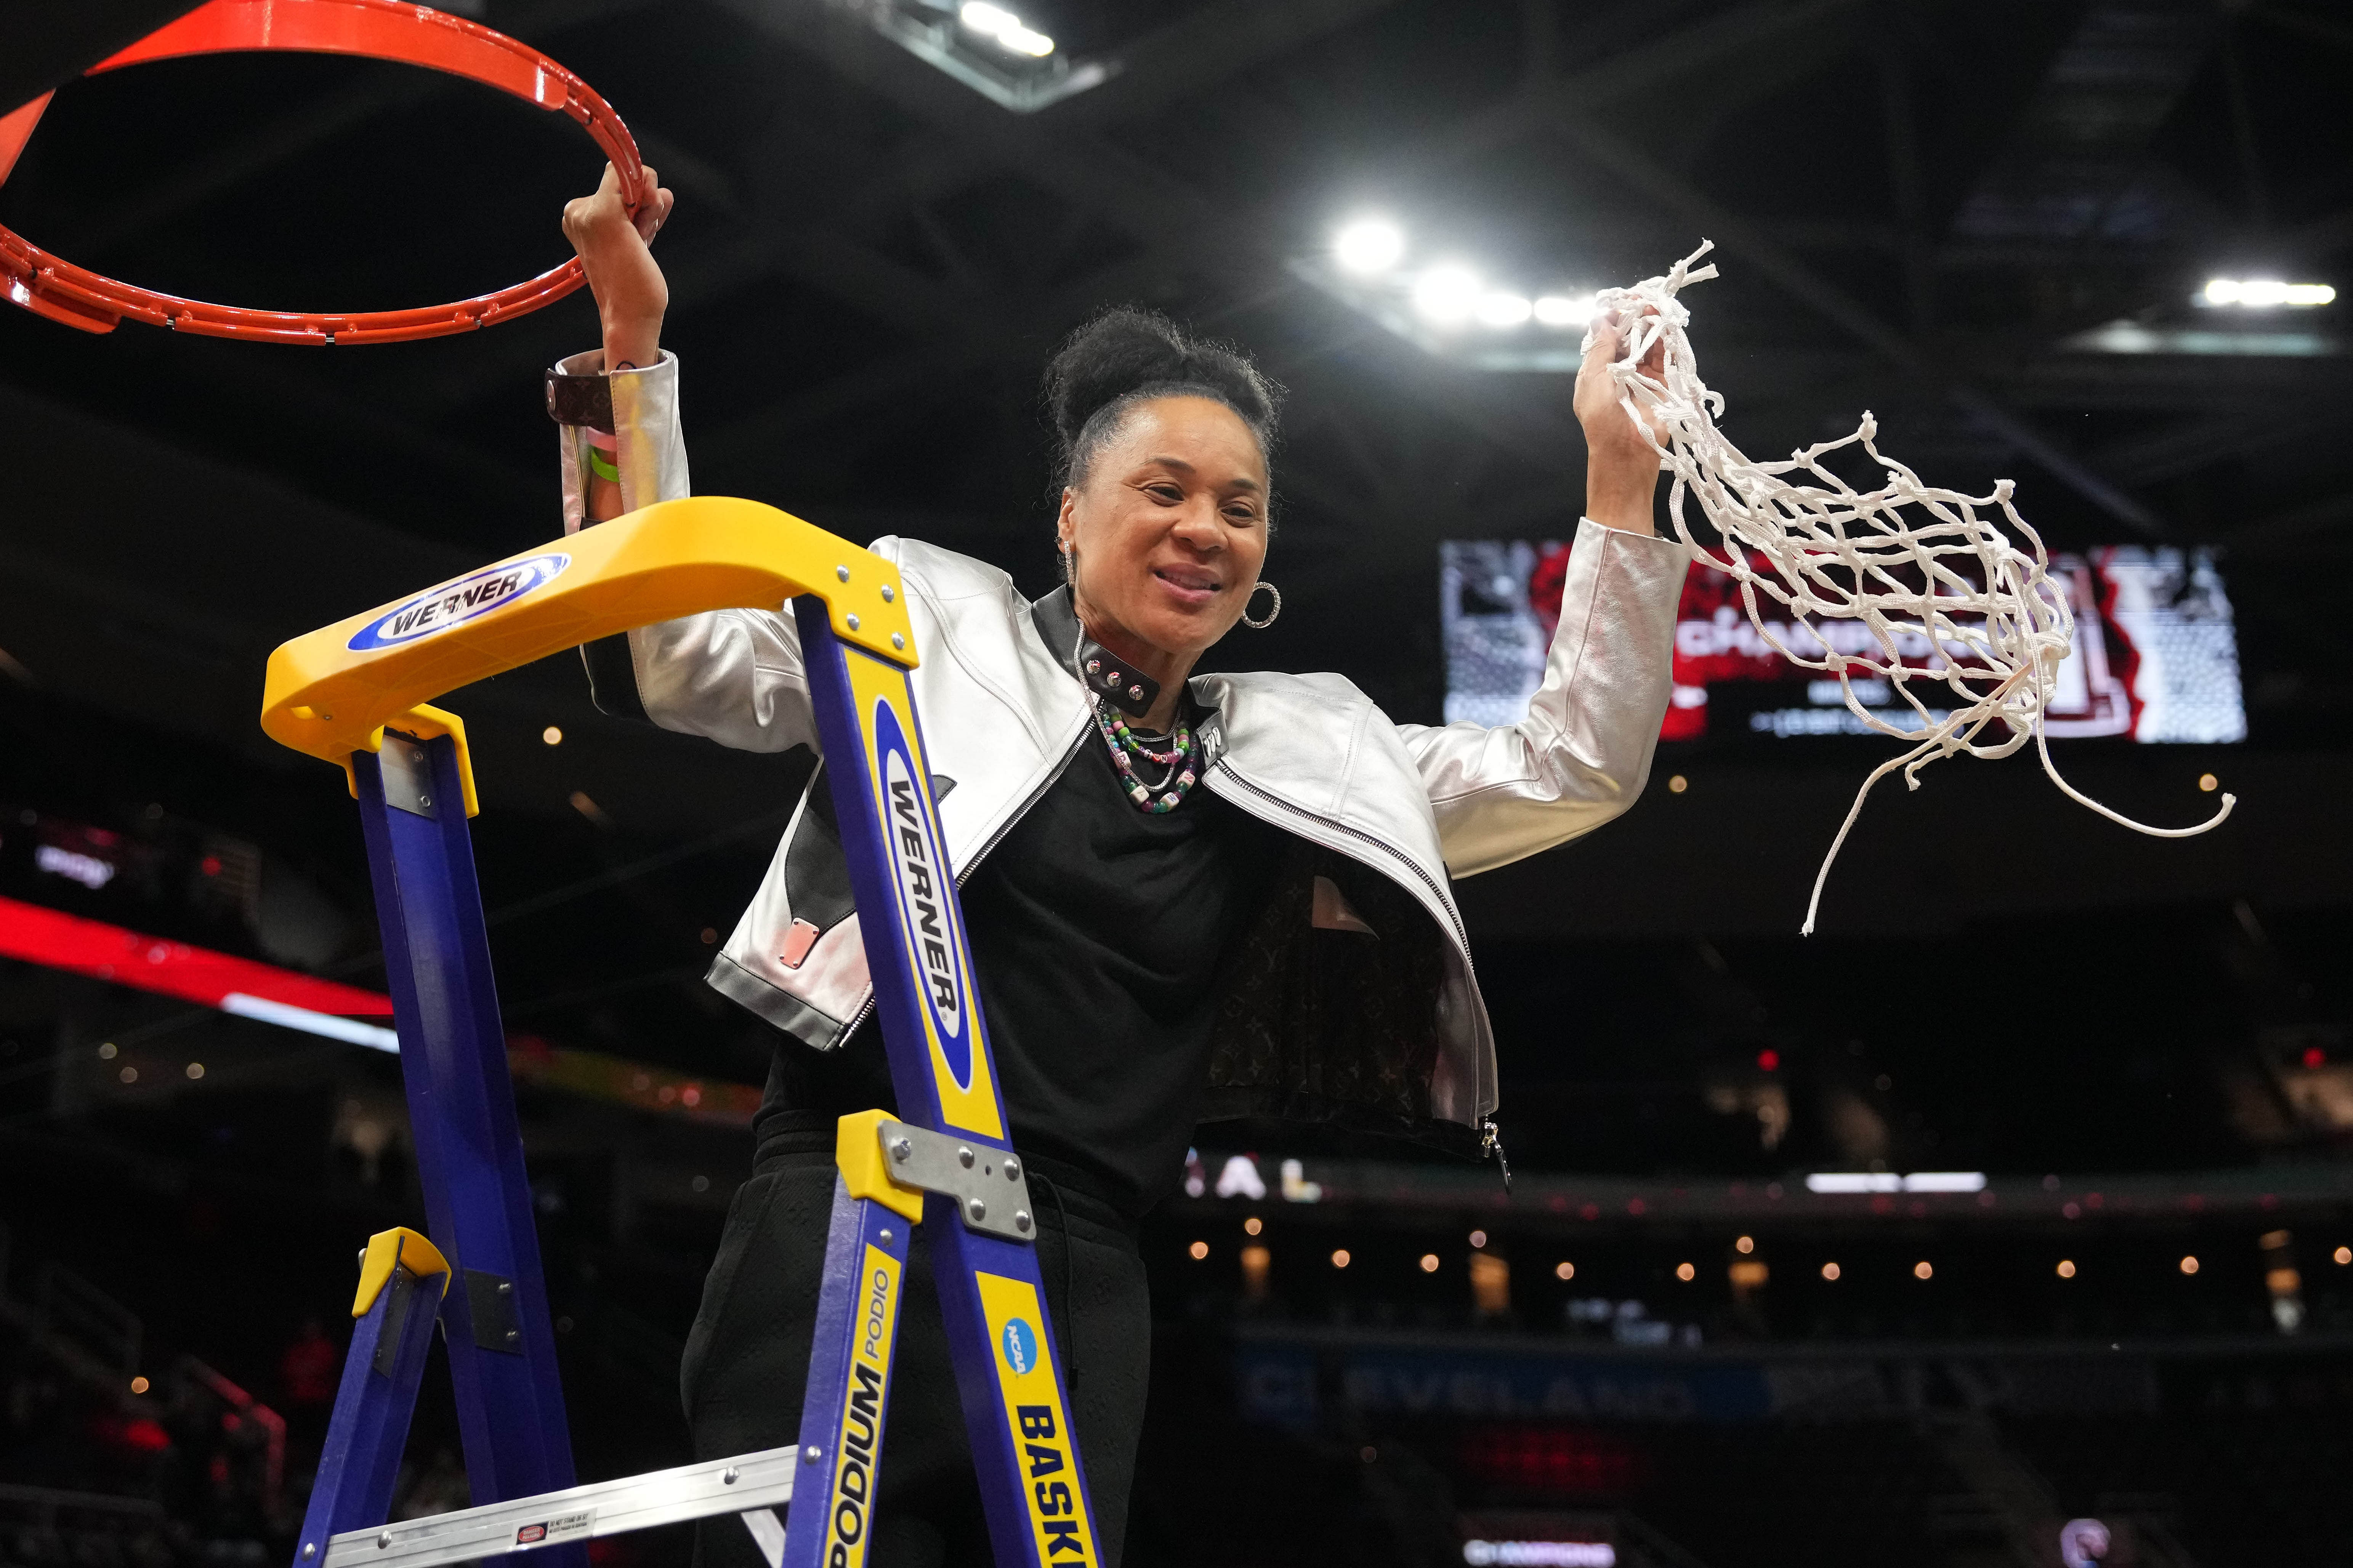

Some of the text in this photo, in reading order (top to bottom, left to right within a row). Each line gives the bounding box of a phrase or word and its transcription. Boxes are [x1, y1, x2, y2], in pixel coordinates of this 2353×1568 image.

[392, 570, 522, 636] WERNER
[890, 778, 957, 1012] WERNER
[864, 1268, 889, 1360] PODIO
[1007, 1325, 1026, 1373] NCAA
[1016, 1405, 1087, 1568] BASK
